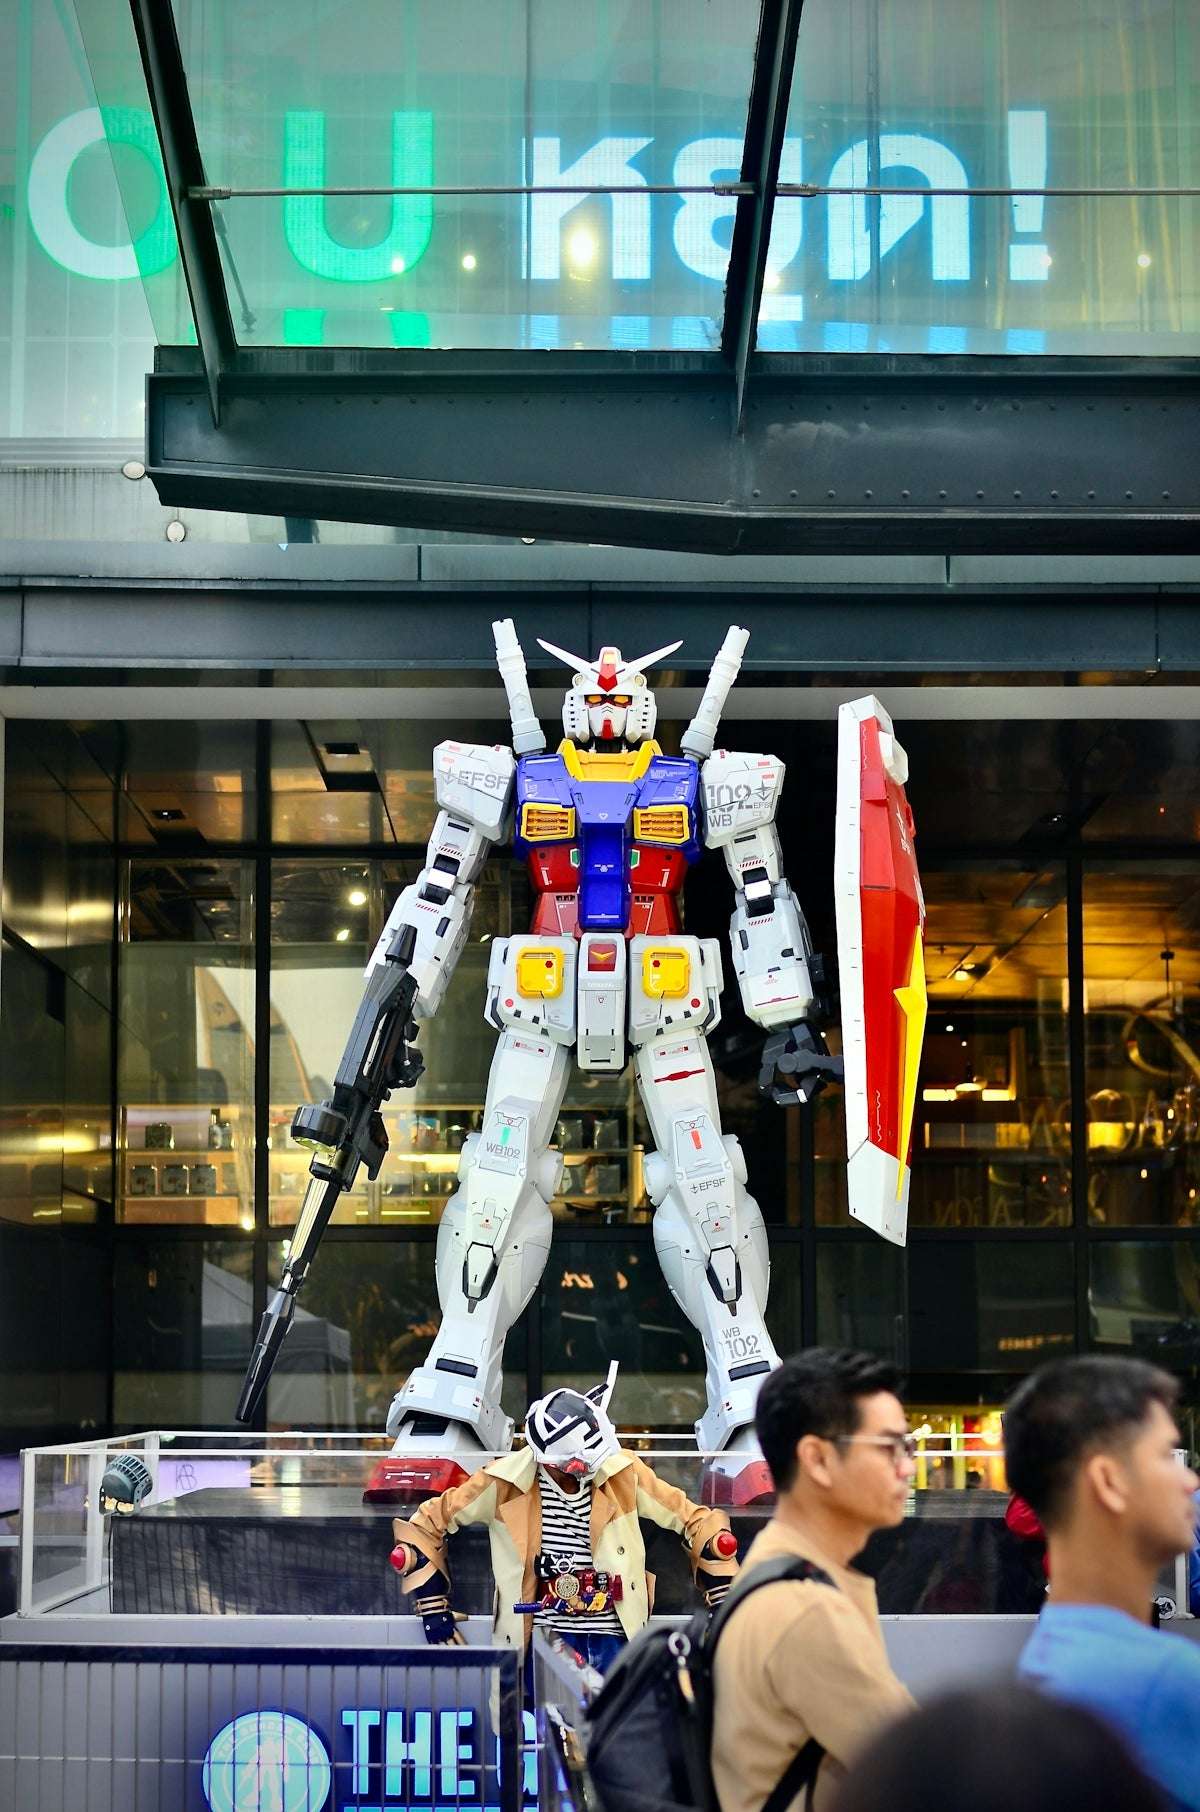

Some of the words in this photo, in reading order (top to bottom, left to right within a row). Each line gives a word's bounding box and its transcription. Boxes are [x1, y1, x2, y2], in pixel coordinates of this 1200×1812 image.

[707, 783, 753, 813] 102
[708, 813, 733, 828] WB
[486, 1142, 521, 1159] WB102
[699, 1177, 726, 1192] EFSF
[722, 1326, 741, 1339] WB
[725, 1334, 762, 1359] 102
[341, 1709, 476, 1797] THE
